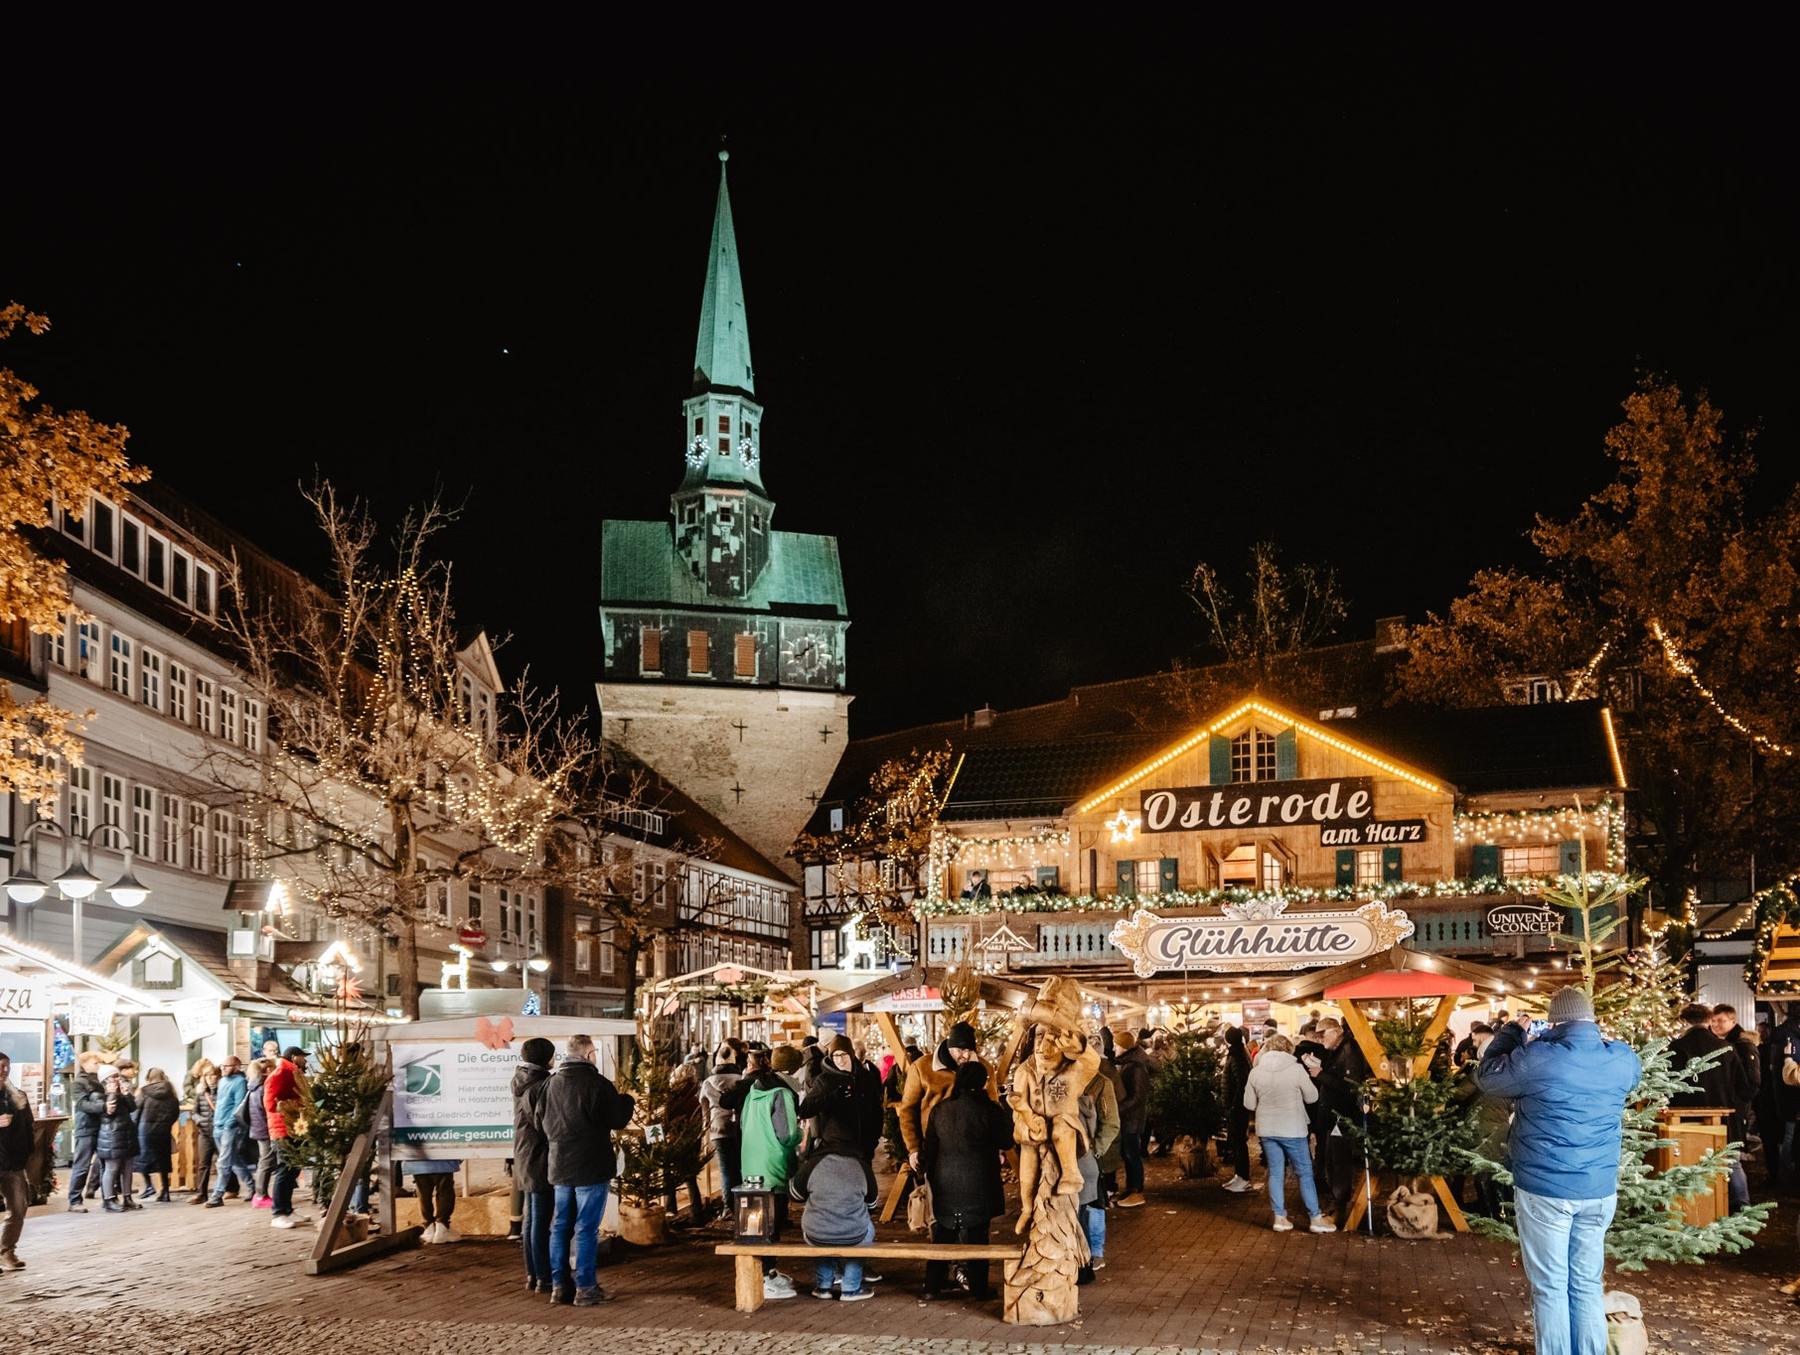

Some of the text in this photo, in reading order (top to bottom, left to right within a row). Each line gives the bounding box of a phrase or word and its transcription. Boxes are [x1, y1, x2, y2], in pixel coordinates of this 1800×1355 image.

[1144, 783, 1371, 830] Osterode
[1322, 822, 1421, 845] am Harz
[1492, 912, 1552, 924] UNIVENT
[1500, 921, 1562, 932] CONCEPT
[1160, 924, 1356, 968] Glühhütte
[893, 985, 927, 1000] CASEA
[458, 1053, 477, 1063] Die
[437, 1110, 471, 1119] Diedrich
[473, 1110, 500, 1118] GmbH
